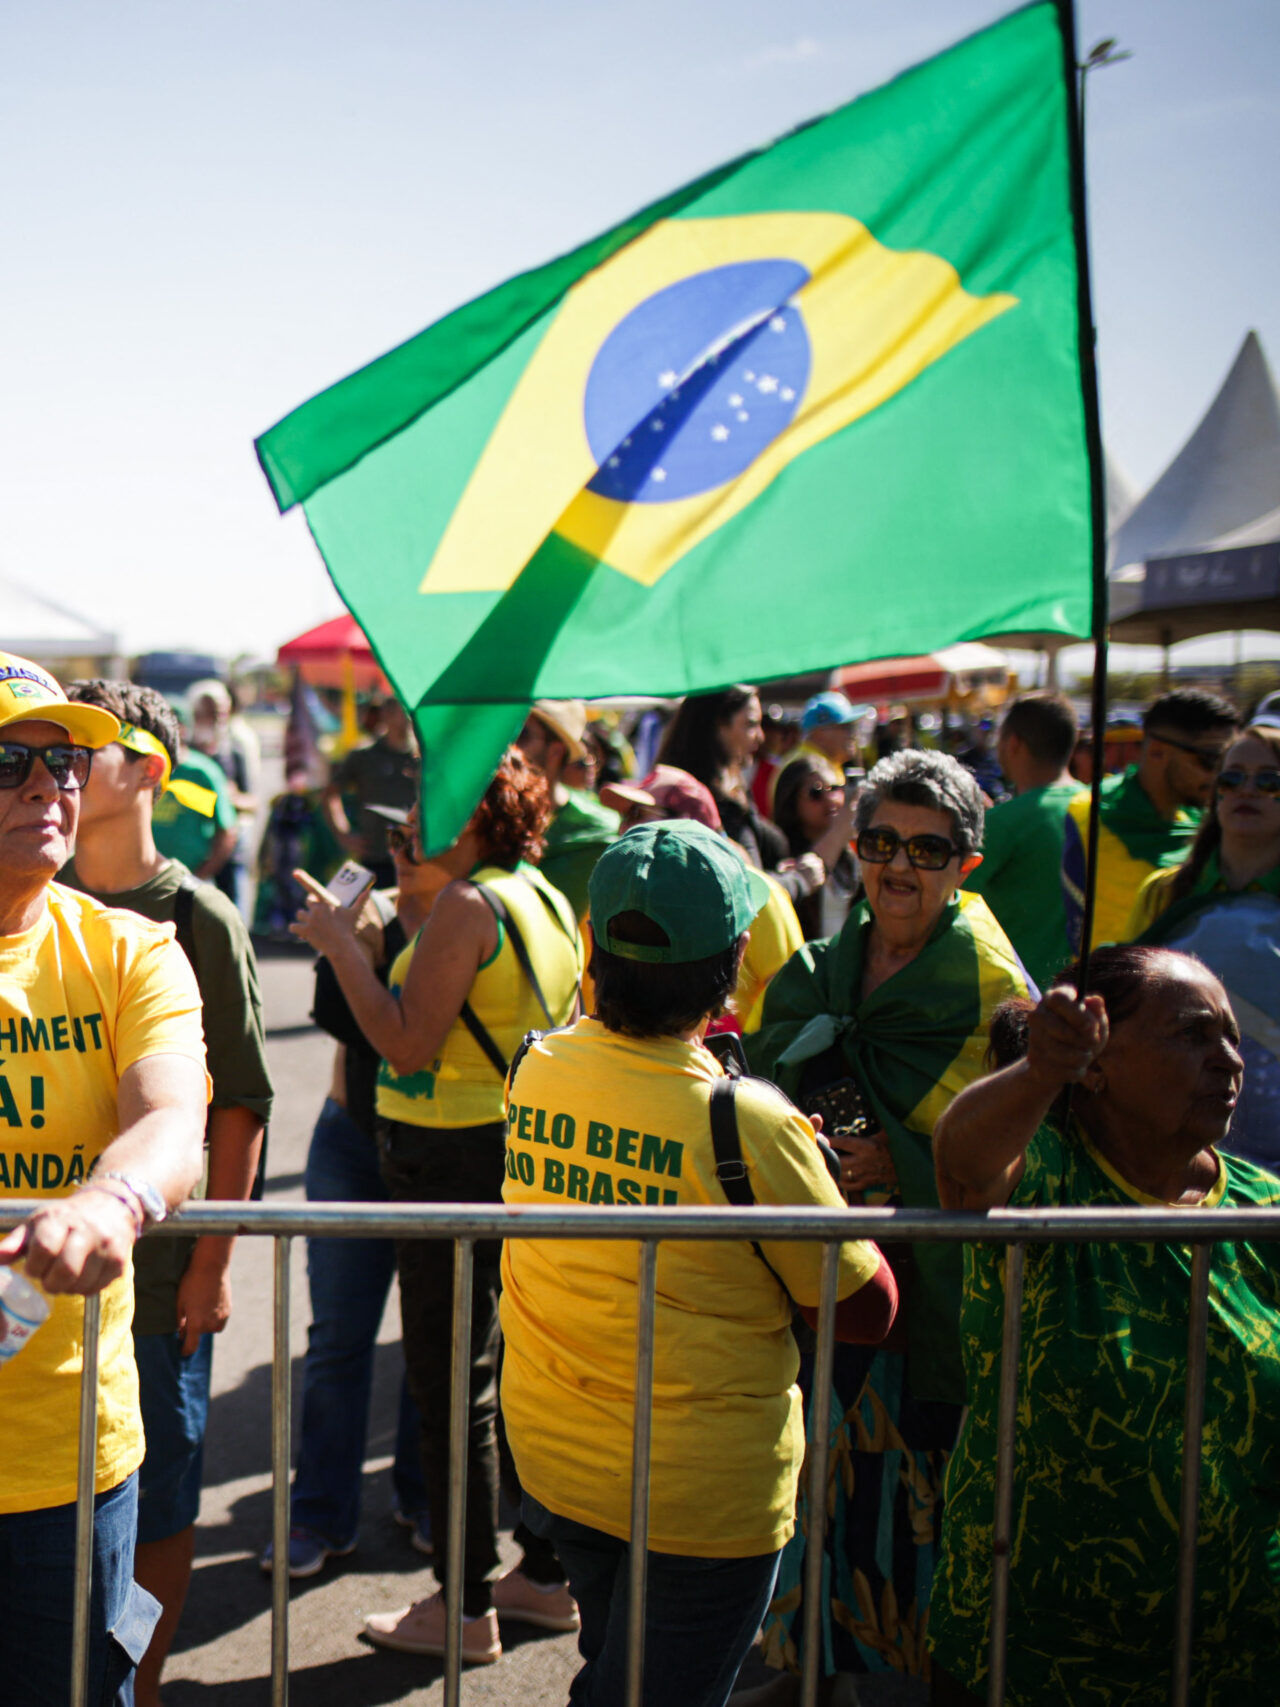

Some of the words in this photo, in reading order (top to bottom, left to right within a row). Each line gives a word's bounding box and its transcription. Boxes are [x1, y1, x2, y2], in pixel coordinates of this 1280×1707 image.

[506, 1147, 535, 1187] DO
[508, 1103, 576, 1150] PELO
[586, 1120, 685, 1179] BEM
